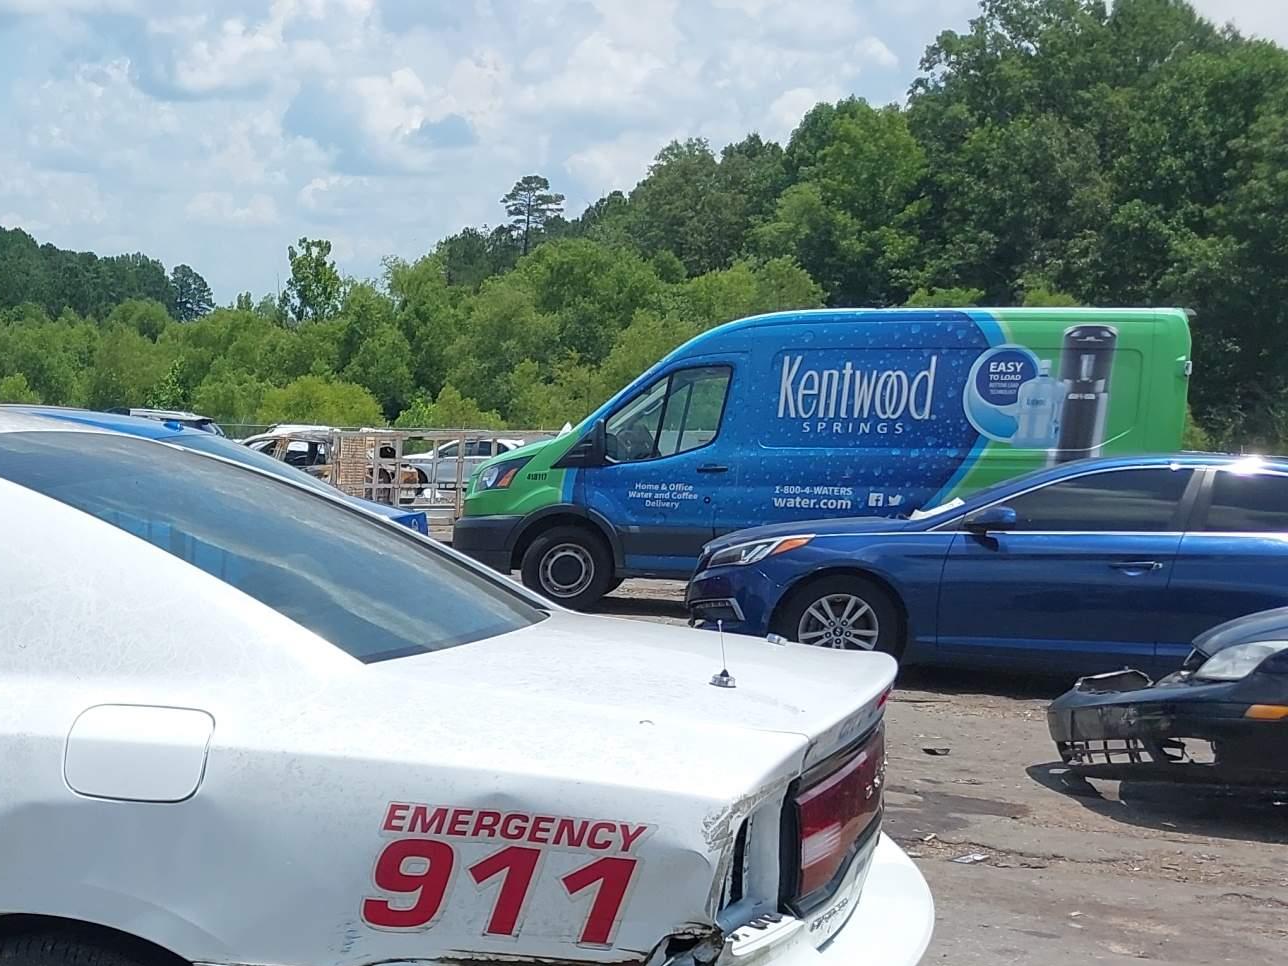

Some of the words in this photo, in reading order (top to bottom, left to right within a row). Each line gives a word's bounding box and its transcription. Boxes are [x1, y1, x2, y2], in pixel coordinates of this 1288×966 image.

[989, 361, 1024, 373] EASY
[777, 354, 938, 420] Kentwood
[802, 421, 904, 435] SPRINGS
[635, 482, 660, 491] Home
[660, 483, 668, 491] &
[669, 483, 694, 492] Office
[628, 490, 653, 499] Water
[653, 491, 670, 499] and
[671, 491, 698, 500] Coffee
[645, 499, 680, 510] Delivery
[773, 497, 852, 510] water.com
[383, 803, 648, 852] EMERGENCY
[362, 838, 638, 944] 911
